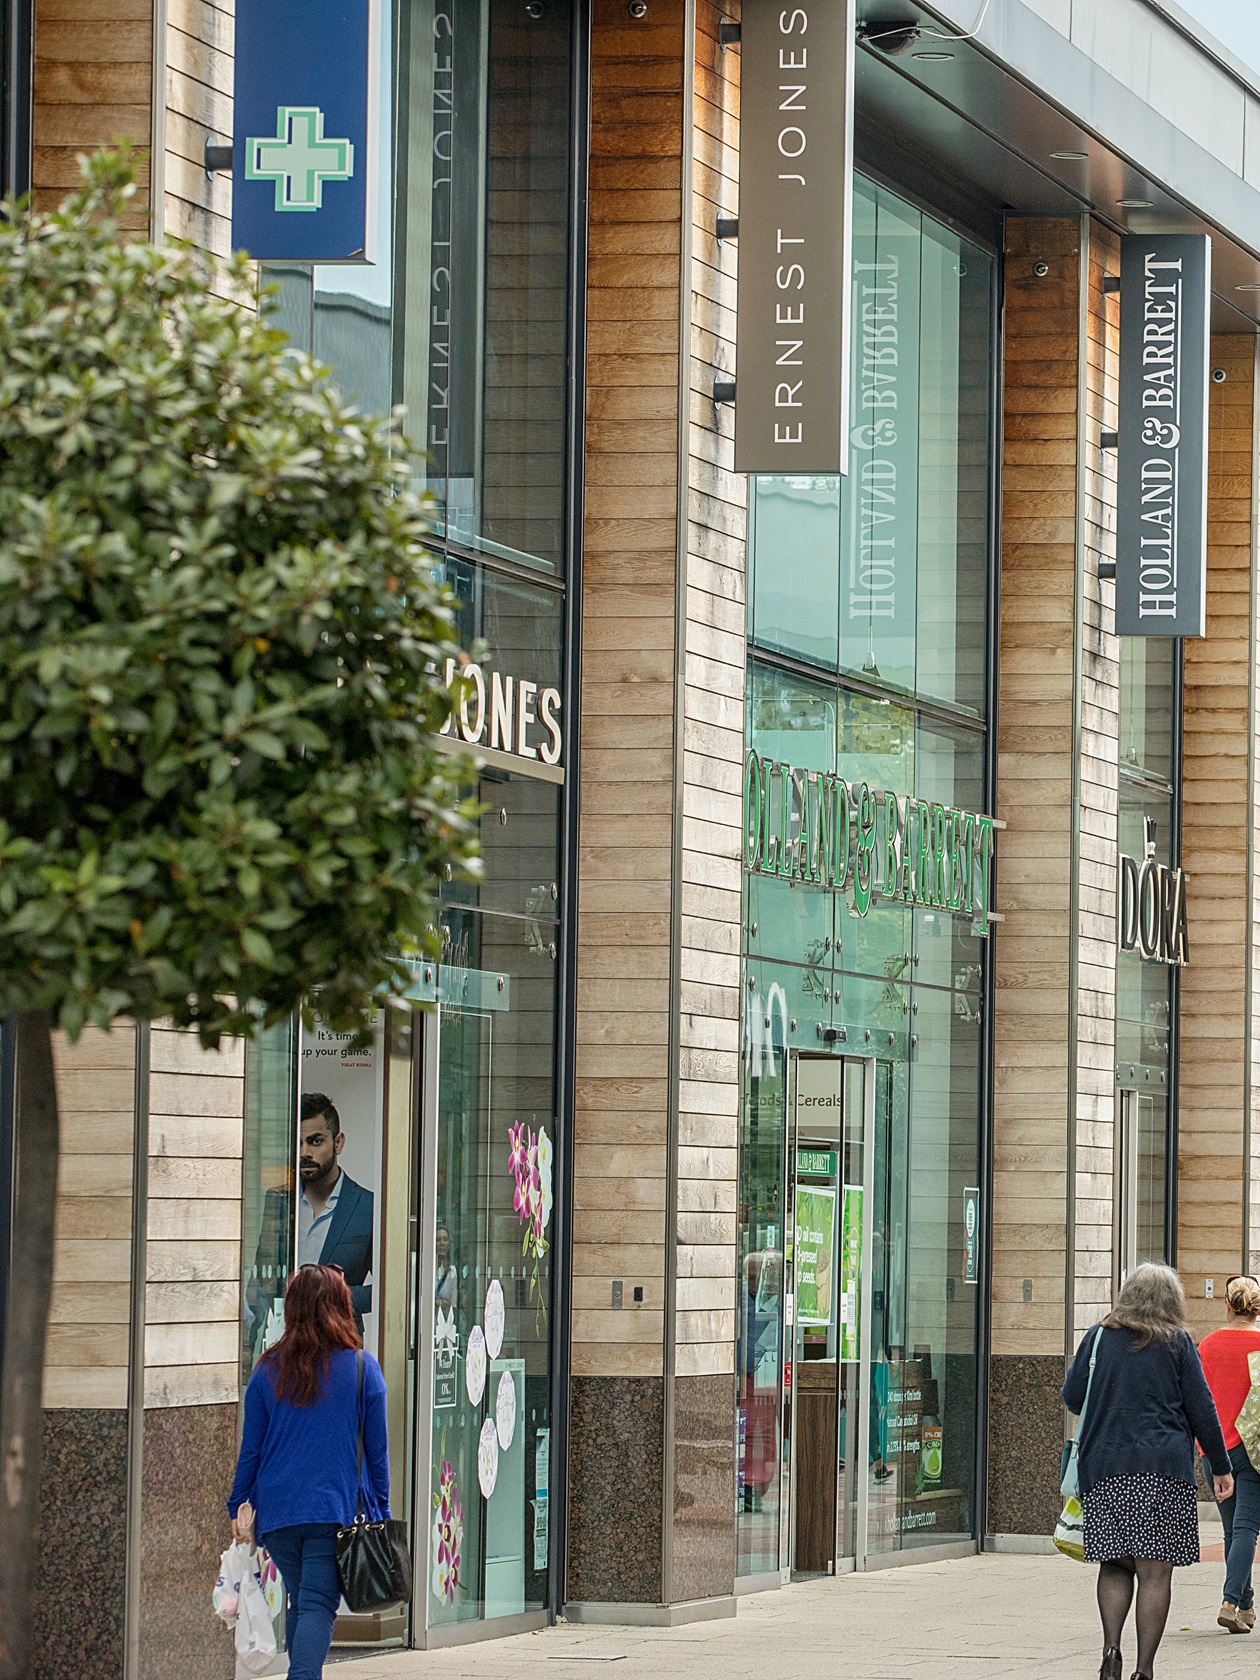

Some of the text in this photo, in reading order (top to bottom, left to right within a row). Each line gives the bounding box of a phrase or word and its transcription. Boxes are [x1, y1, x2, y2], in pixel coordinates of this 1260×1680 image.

[774, 7, 808, 443] ERNEST JONES
[1138, 252, 1183, 620] HOLLAND & BARRETT
[744, 748, 994, 938] OLLAND & BARRETT
[1119, 853, 1190, 967] DORA
[315, 1048, 338, 1059] your
[341, 1049, 372, 1059] game.
[318, 1030, 358, 1041] It's time
